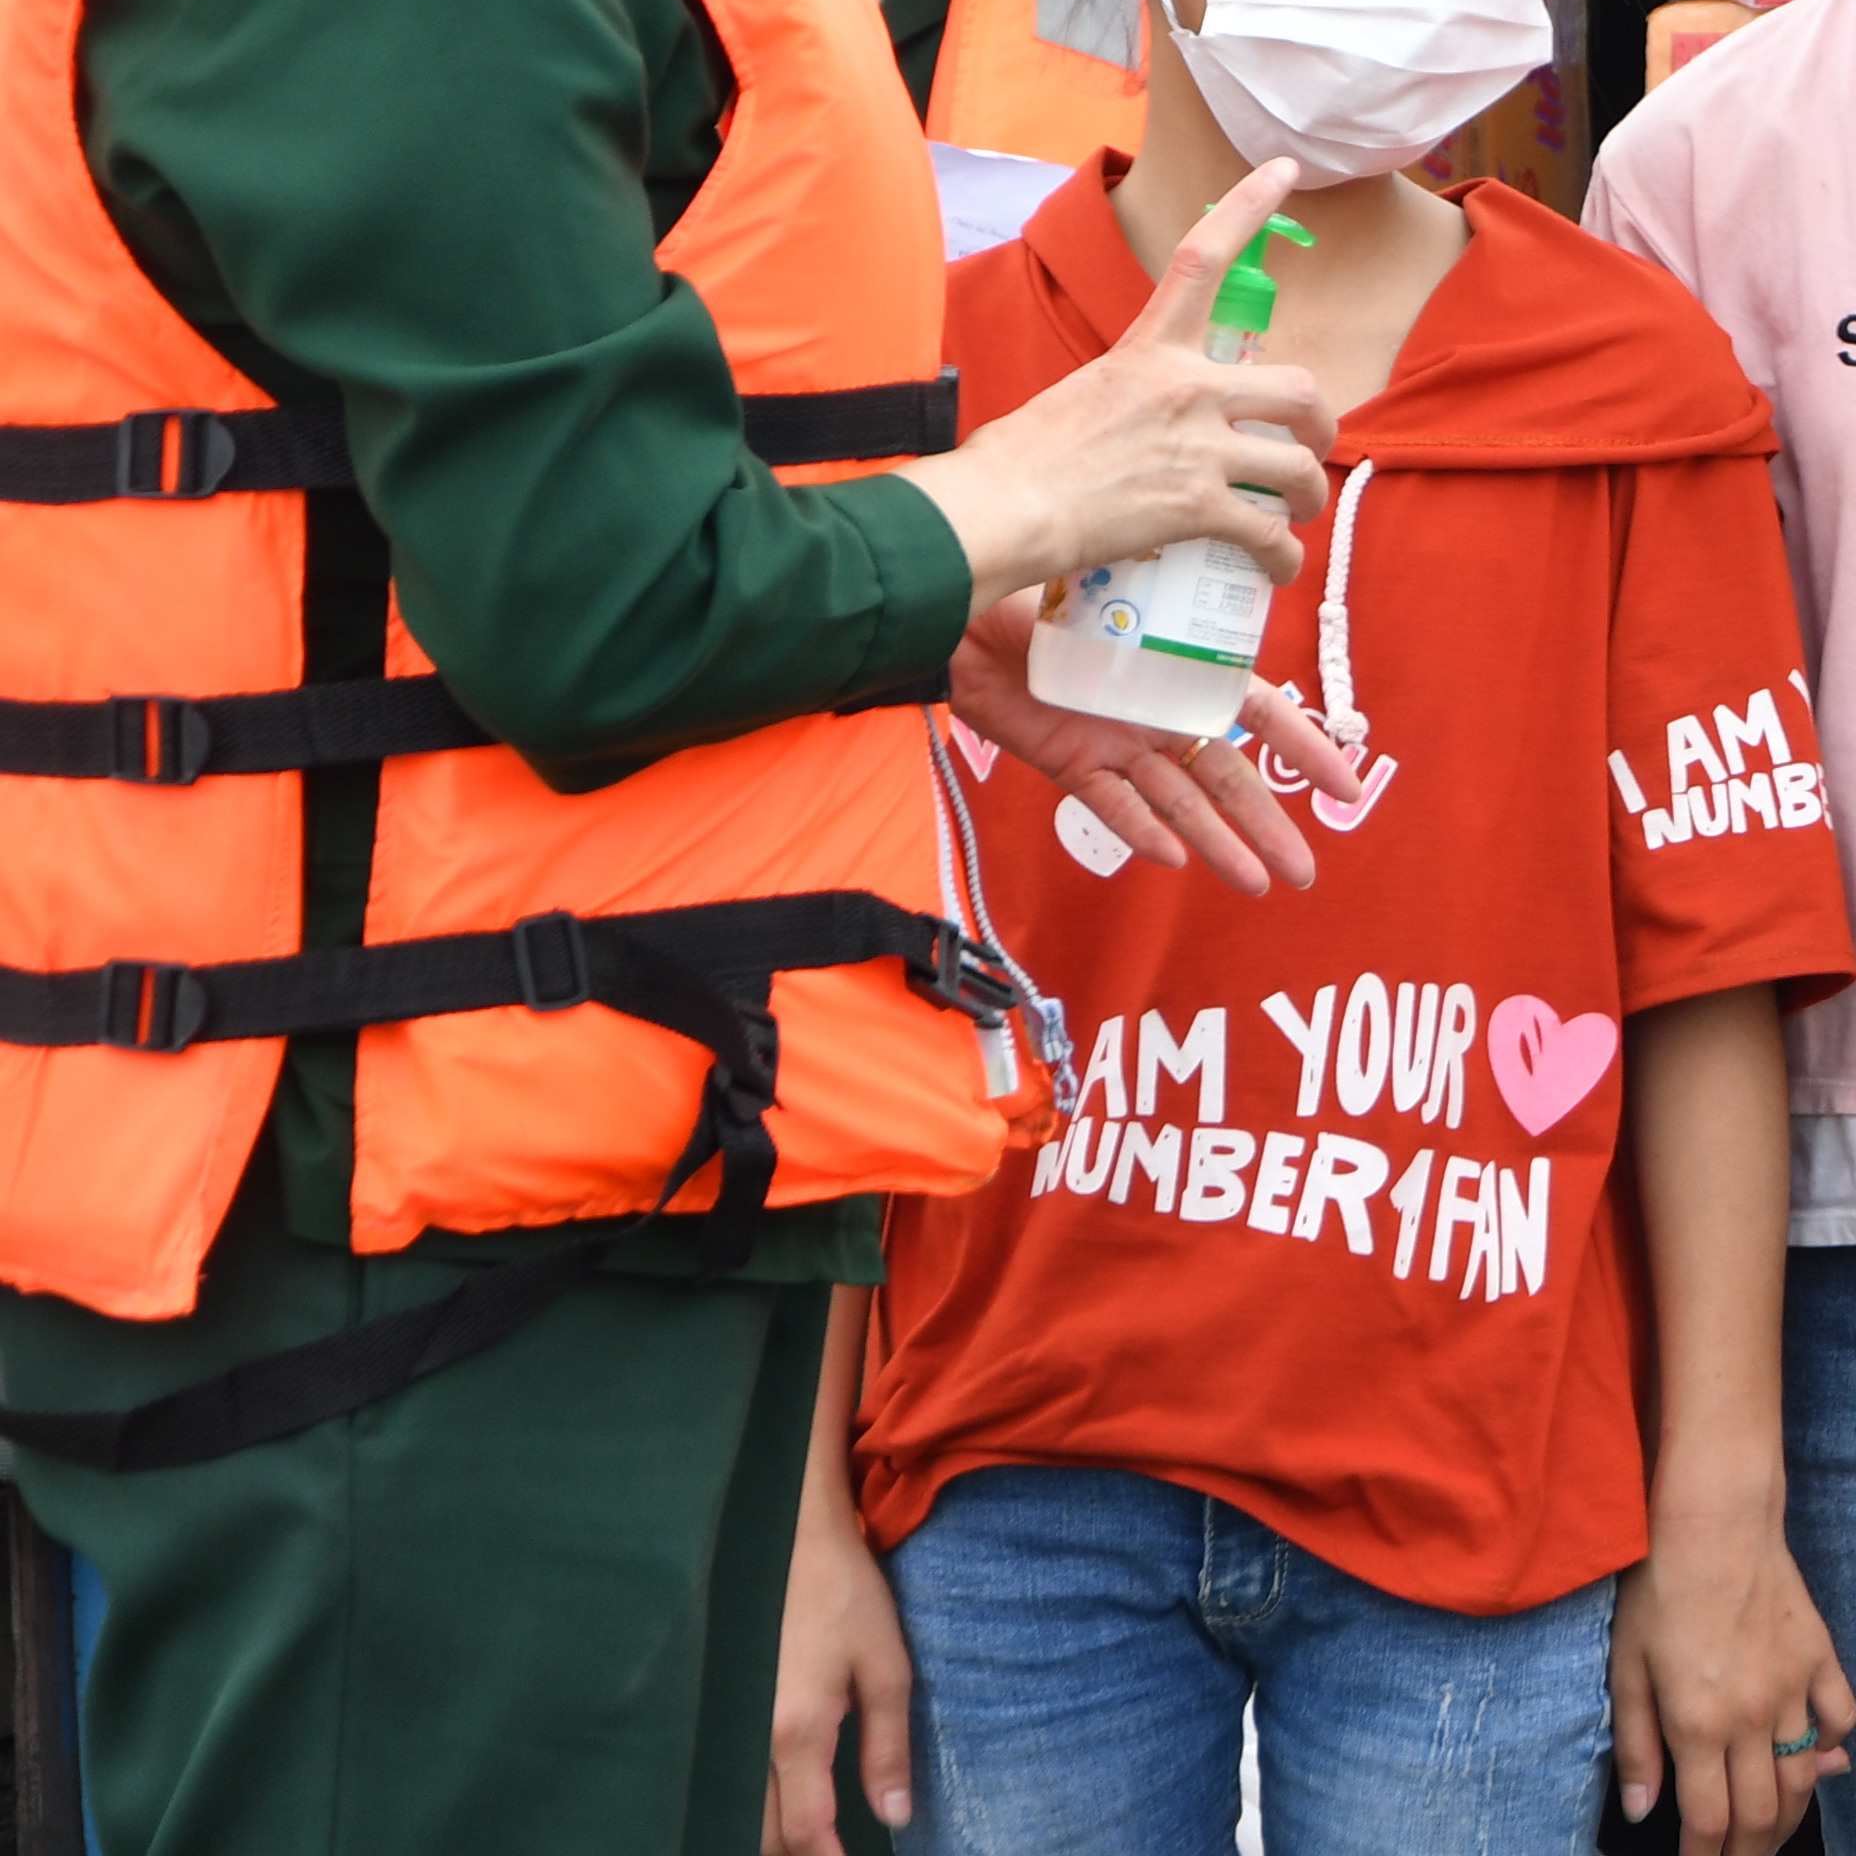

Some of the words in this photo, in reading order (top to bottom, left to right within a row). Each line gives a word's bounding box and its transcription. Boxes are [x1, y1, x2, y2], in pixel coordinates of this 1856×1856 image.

[1607, 749, 1647, 814] I
[1666, 688, 1792, 794] AM
[1641, 762, 1834, 850] NUMB
[1070, 1004, 1228, 1124] AM
[1258, 970, 1476, 1131] YOUR
